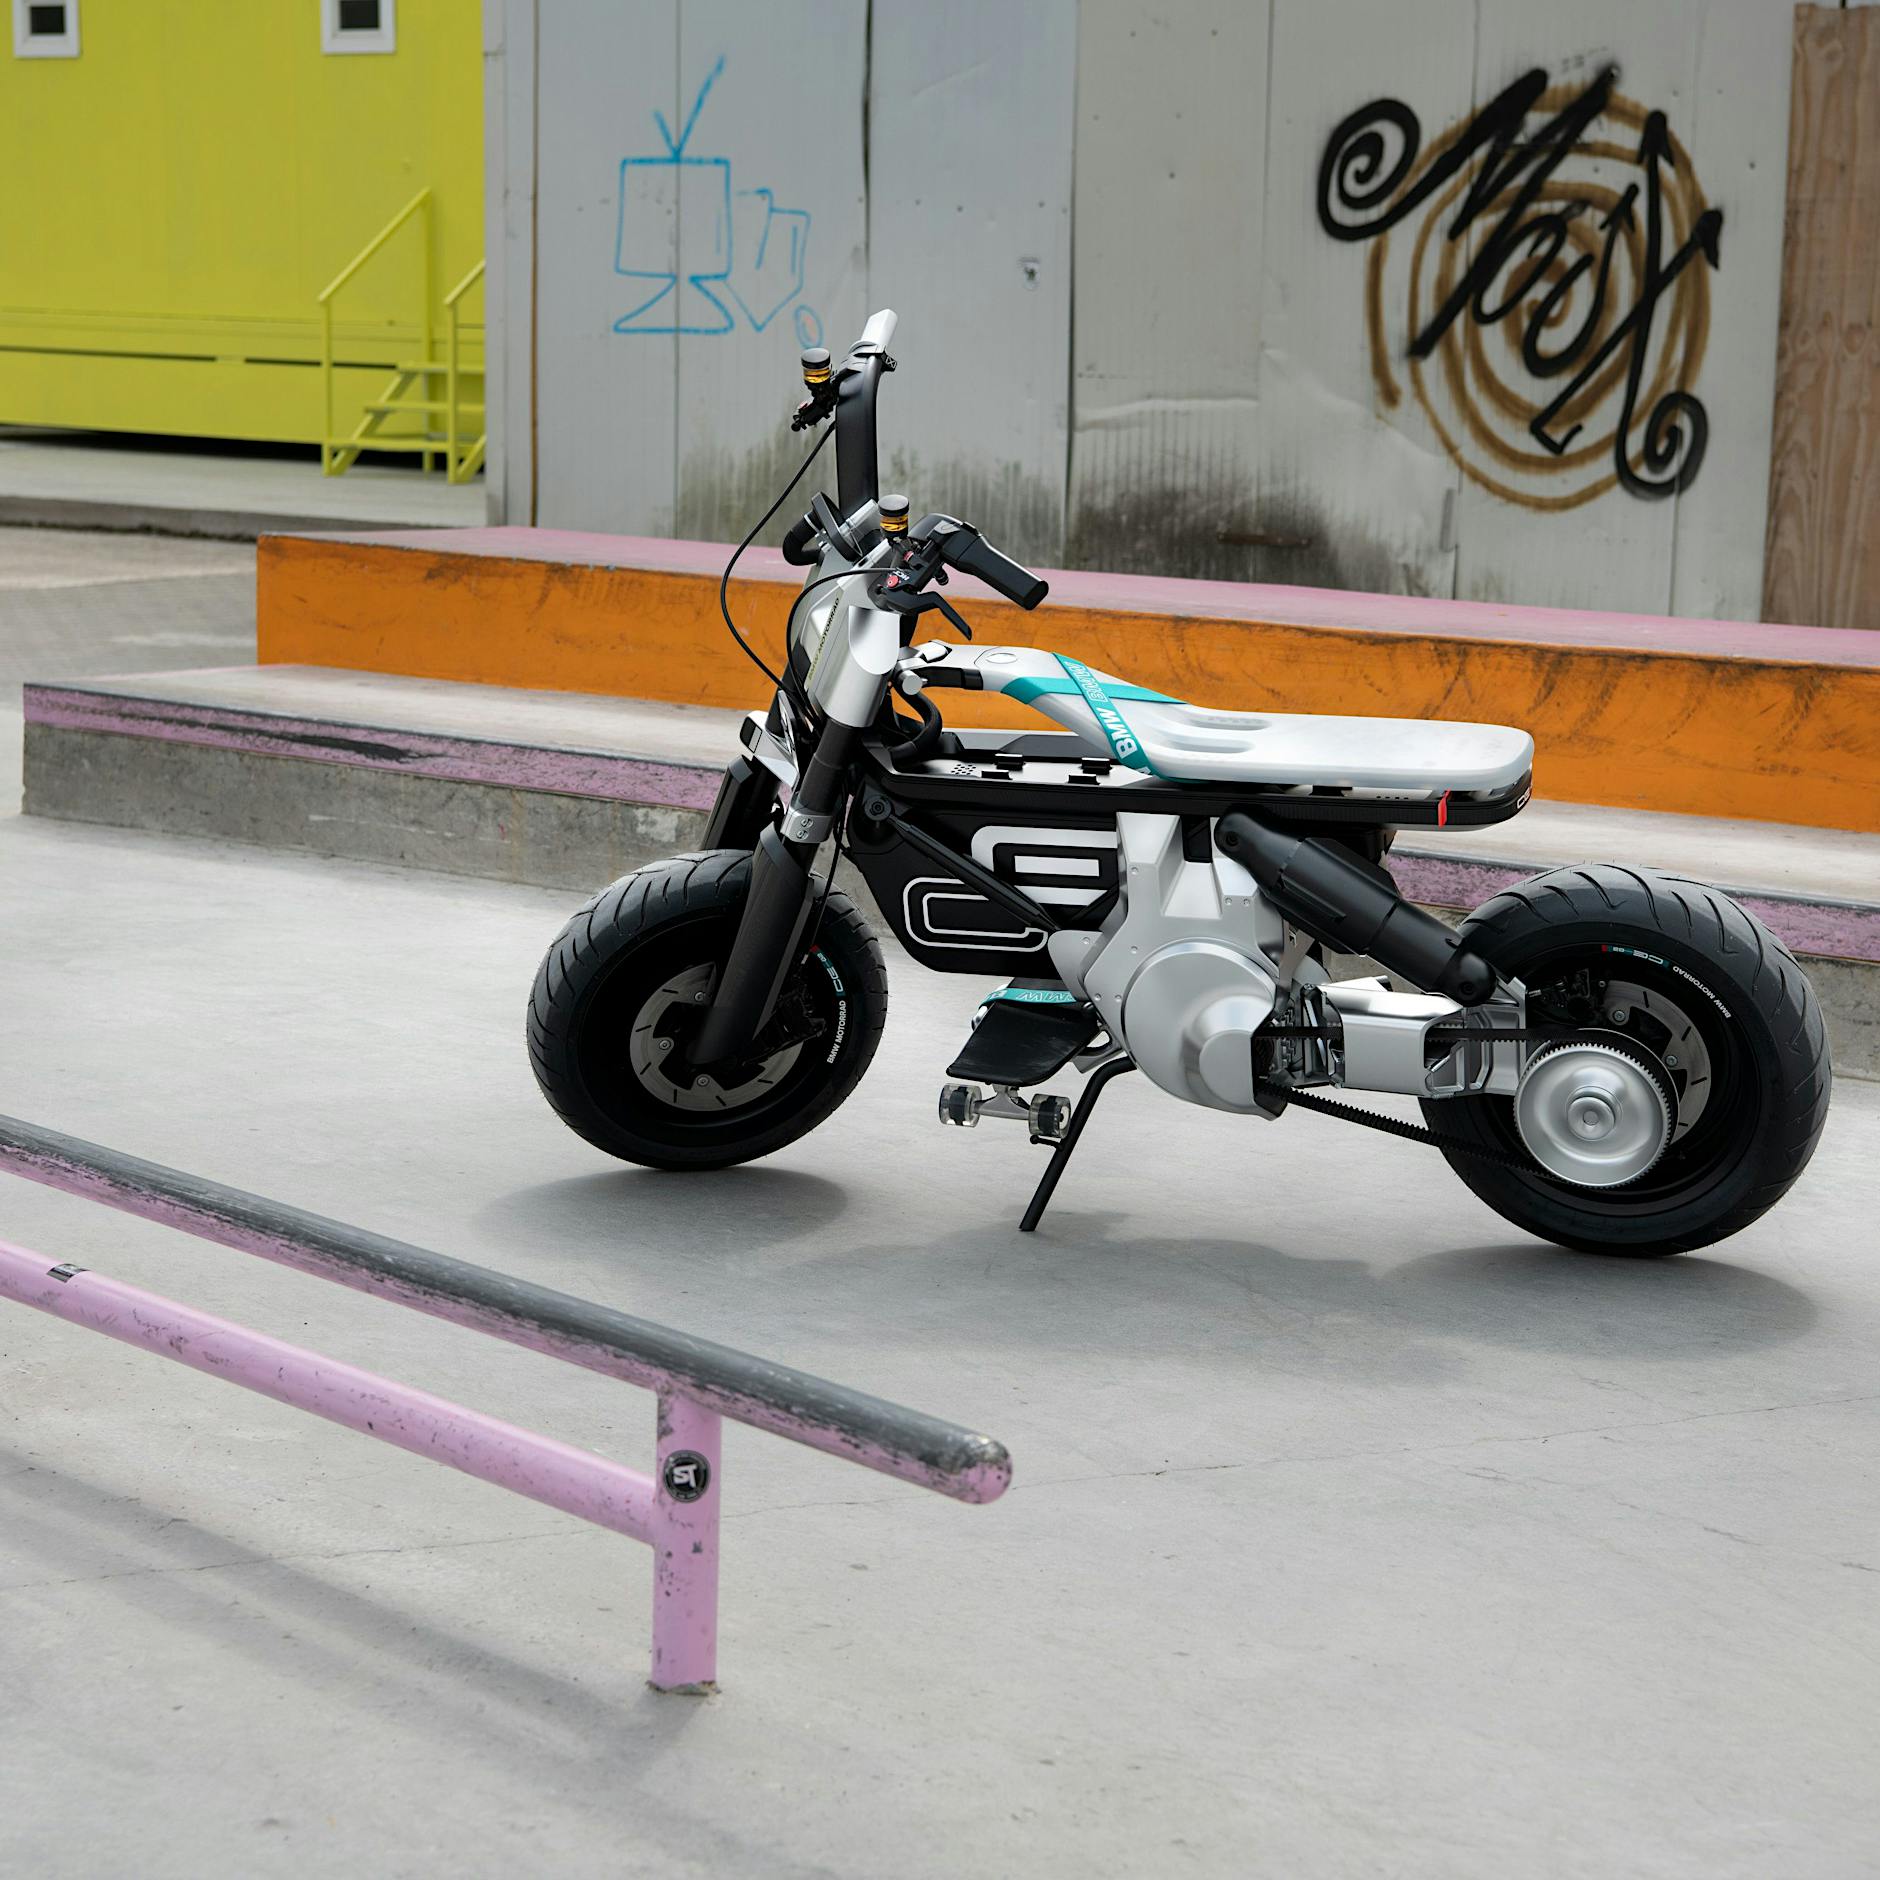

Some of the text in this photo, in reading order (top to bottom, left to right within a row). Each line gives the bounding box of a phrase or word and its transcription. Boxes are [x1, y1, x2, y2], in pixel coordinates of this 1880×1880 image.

[1096, 706, 1138, 759] BMW
[1672, 965, 1716, 1000] MOTORRAD
[1713, 999, 1732, 1018] BMW
[826, 1043, 841, 1064] BMW
[834, 1000, 847, 1043] MOTORRAD
